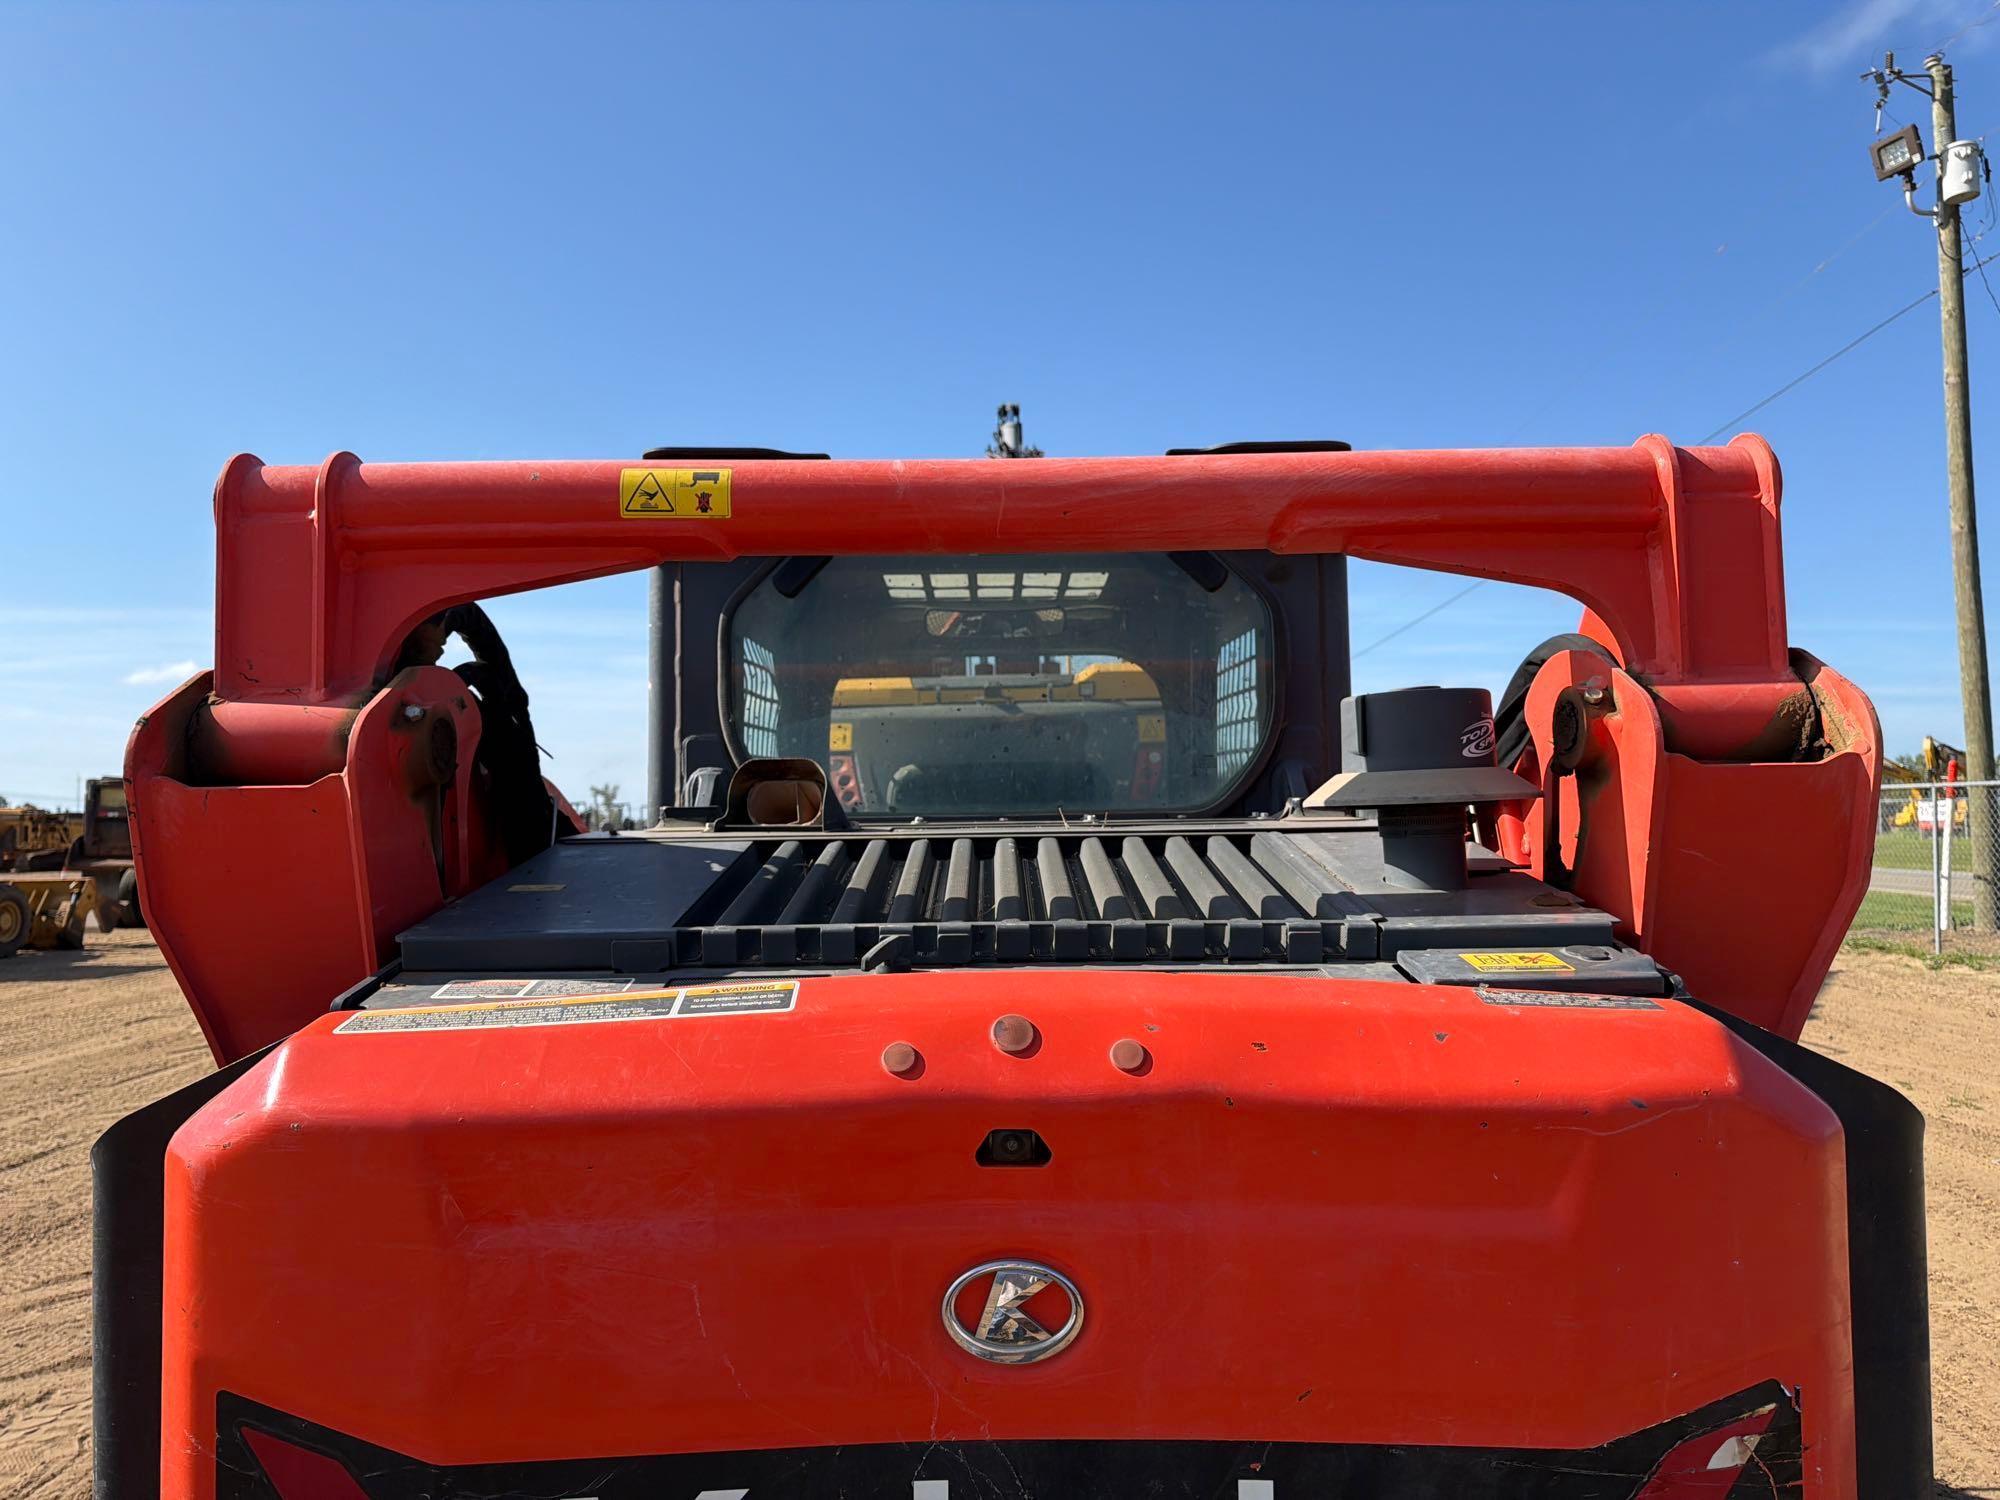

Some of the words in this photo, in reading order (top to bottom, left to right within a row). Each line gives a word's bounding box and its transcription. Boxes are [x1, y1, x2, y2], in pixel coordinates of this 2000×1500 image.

[1460, 726, 1487, 744] TOP
[721, 984, 775, 993] WARNING
[511, 999, 562, 1007] WARNING
